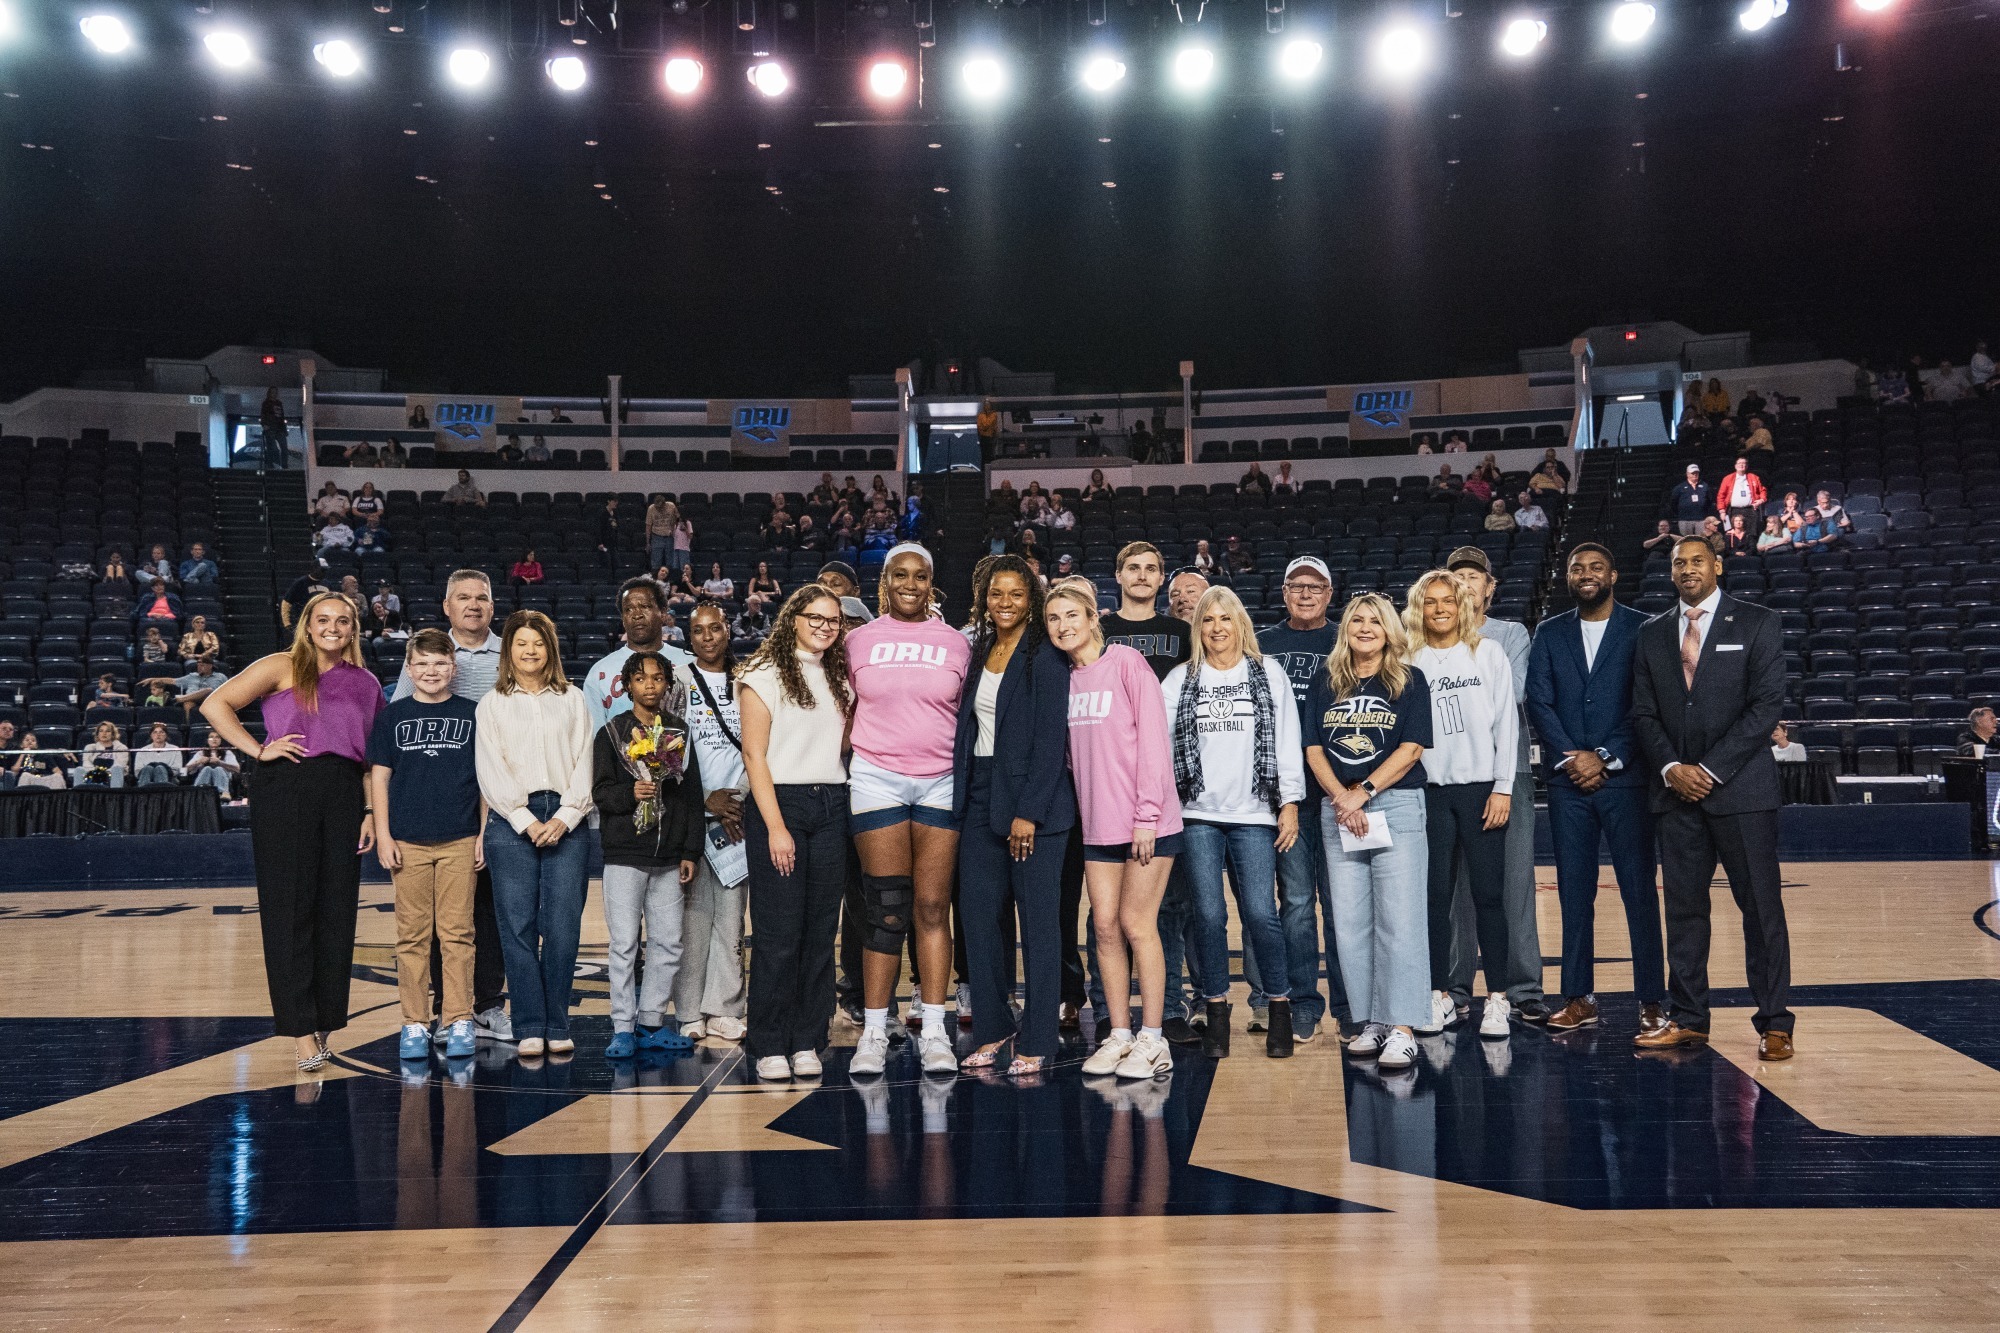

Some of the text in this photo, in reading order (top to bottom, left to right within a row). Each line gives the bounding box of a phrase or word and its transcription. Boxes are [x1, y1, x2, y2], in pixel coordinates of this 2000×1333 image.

[1355, 390, 1413, 412] ORU
[435, 403, 495, 424] ORU
[734, 407, 791, 427] ORU
[869, 643, 947, 666] ORU
[1213, 682, 1250, 695] ROBERT
[1438, 676, 1481, 691] Roberts
[1068, 691, 1113, 717] RU
[1199, 691, 1250, 699] NIVERSITY
[1323, 711, 1397, 725] ORAL ROBERTS
[1437, 695, 1464, 735] 11
[395, 718, 472, 748] ORU
[1199, 720, 1245, 733] BASKETBALL
